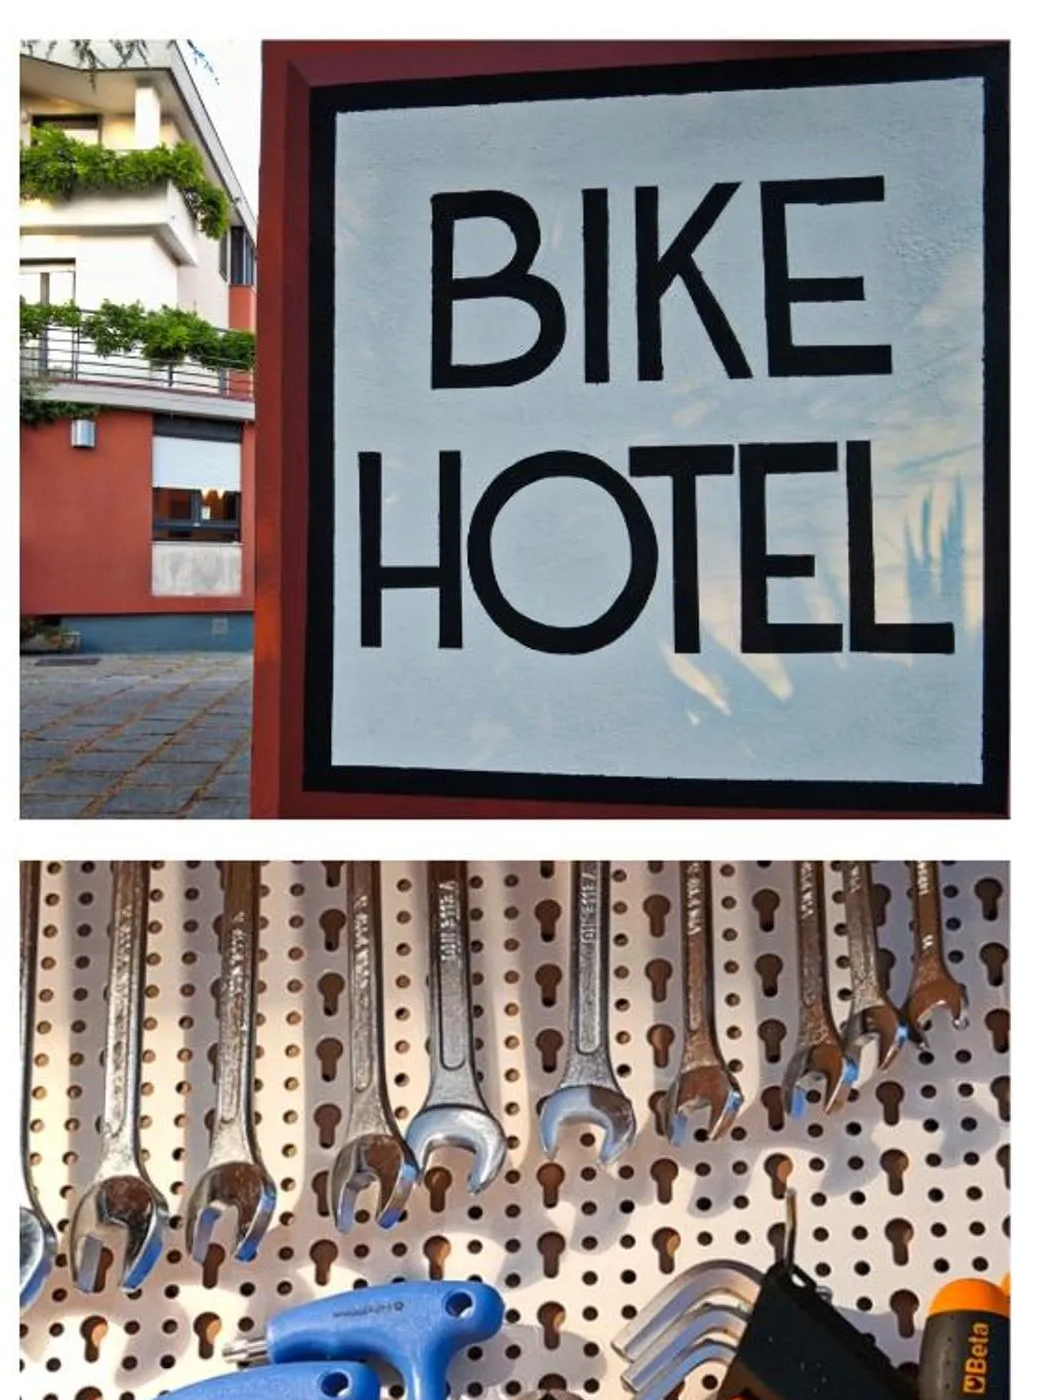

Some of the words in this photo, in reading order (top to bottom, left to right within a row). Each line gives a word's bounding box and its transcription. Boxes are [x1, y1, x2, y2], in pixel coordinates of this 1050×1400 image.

[430, 174, 893, 390] BIKE
[357, 440, 956, 656] HOTEL
[965, 1322, 989, 1375] Beta
